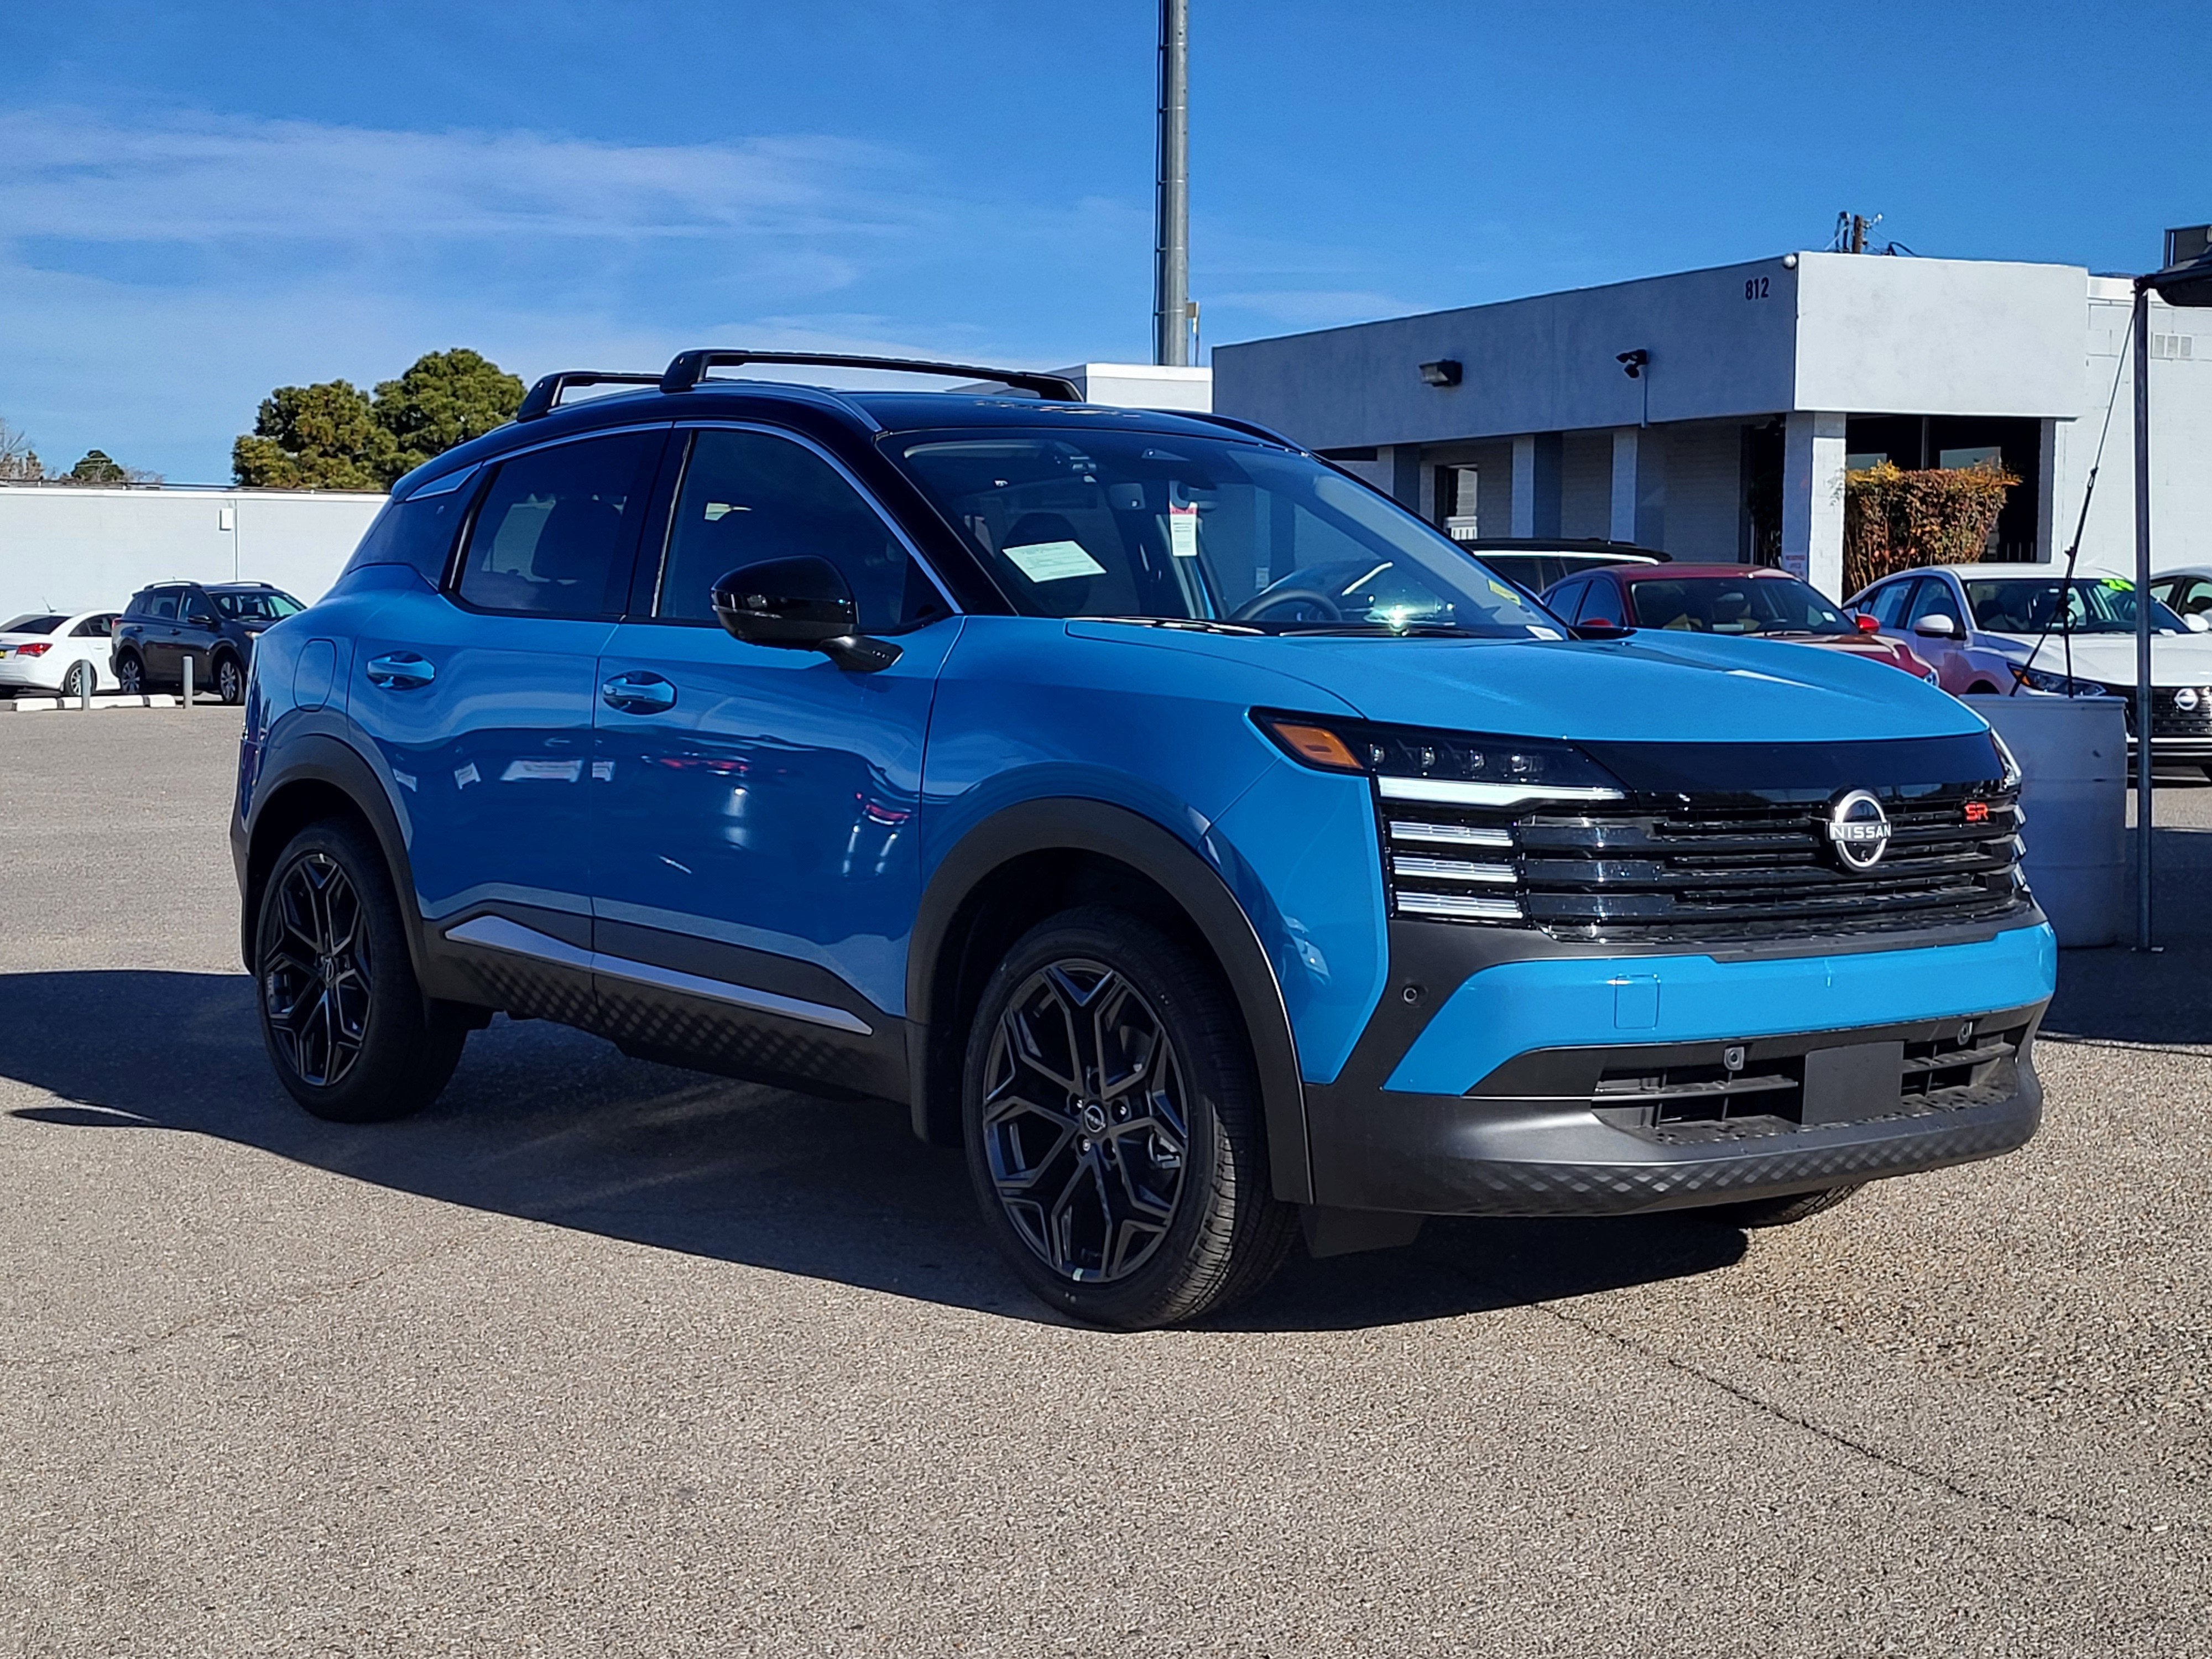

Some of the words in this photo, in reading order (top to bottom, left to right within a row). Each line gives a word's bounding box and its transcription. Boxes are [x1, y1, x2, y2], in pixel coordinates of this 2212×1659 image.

[1745, 276, 1770, 301] 812
[1964, 802, 1989, 821] SR
[1832, 823, 1892, 839] NISSAN
